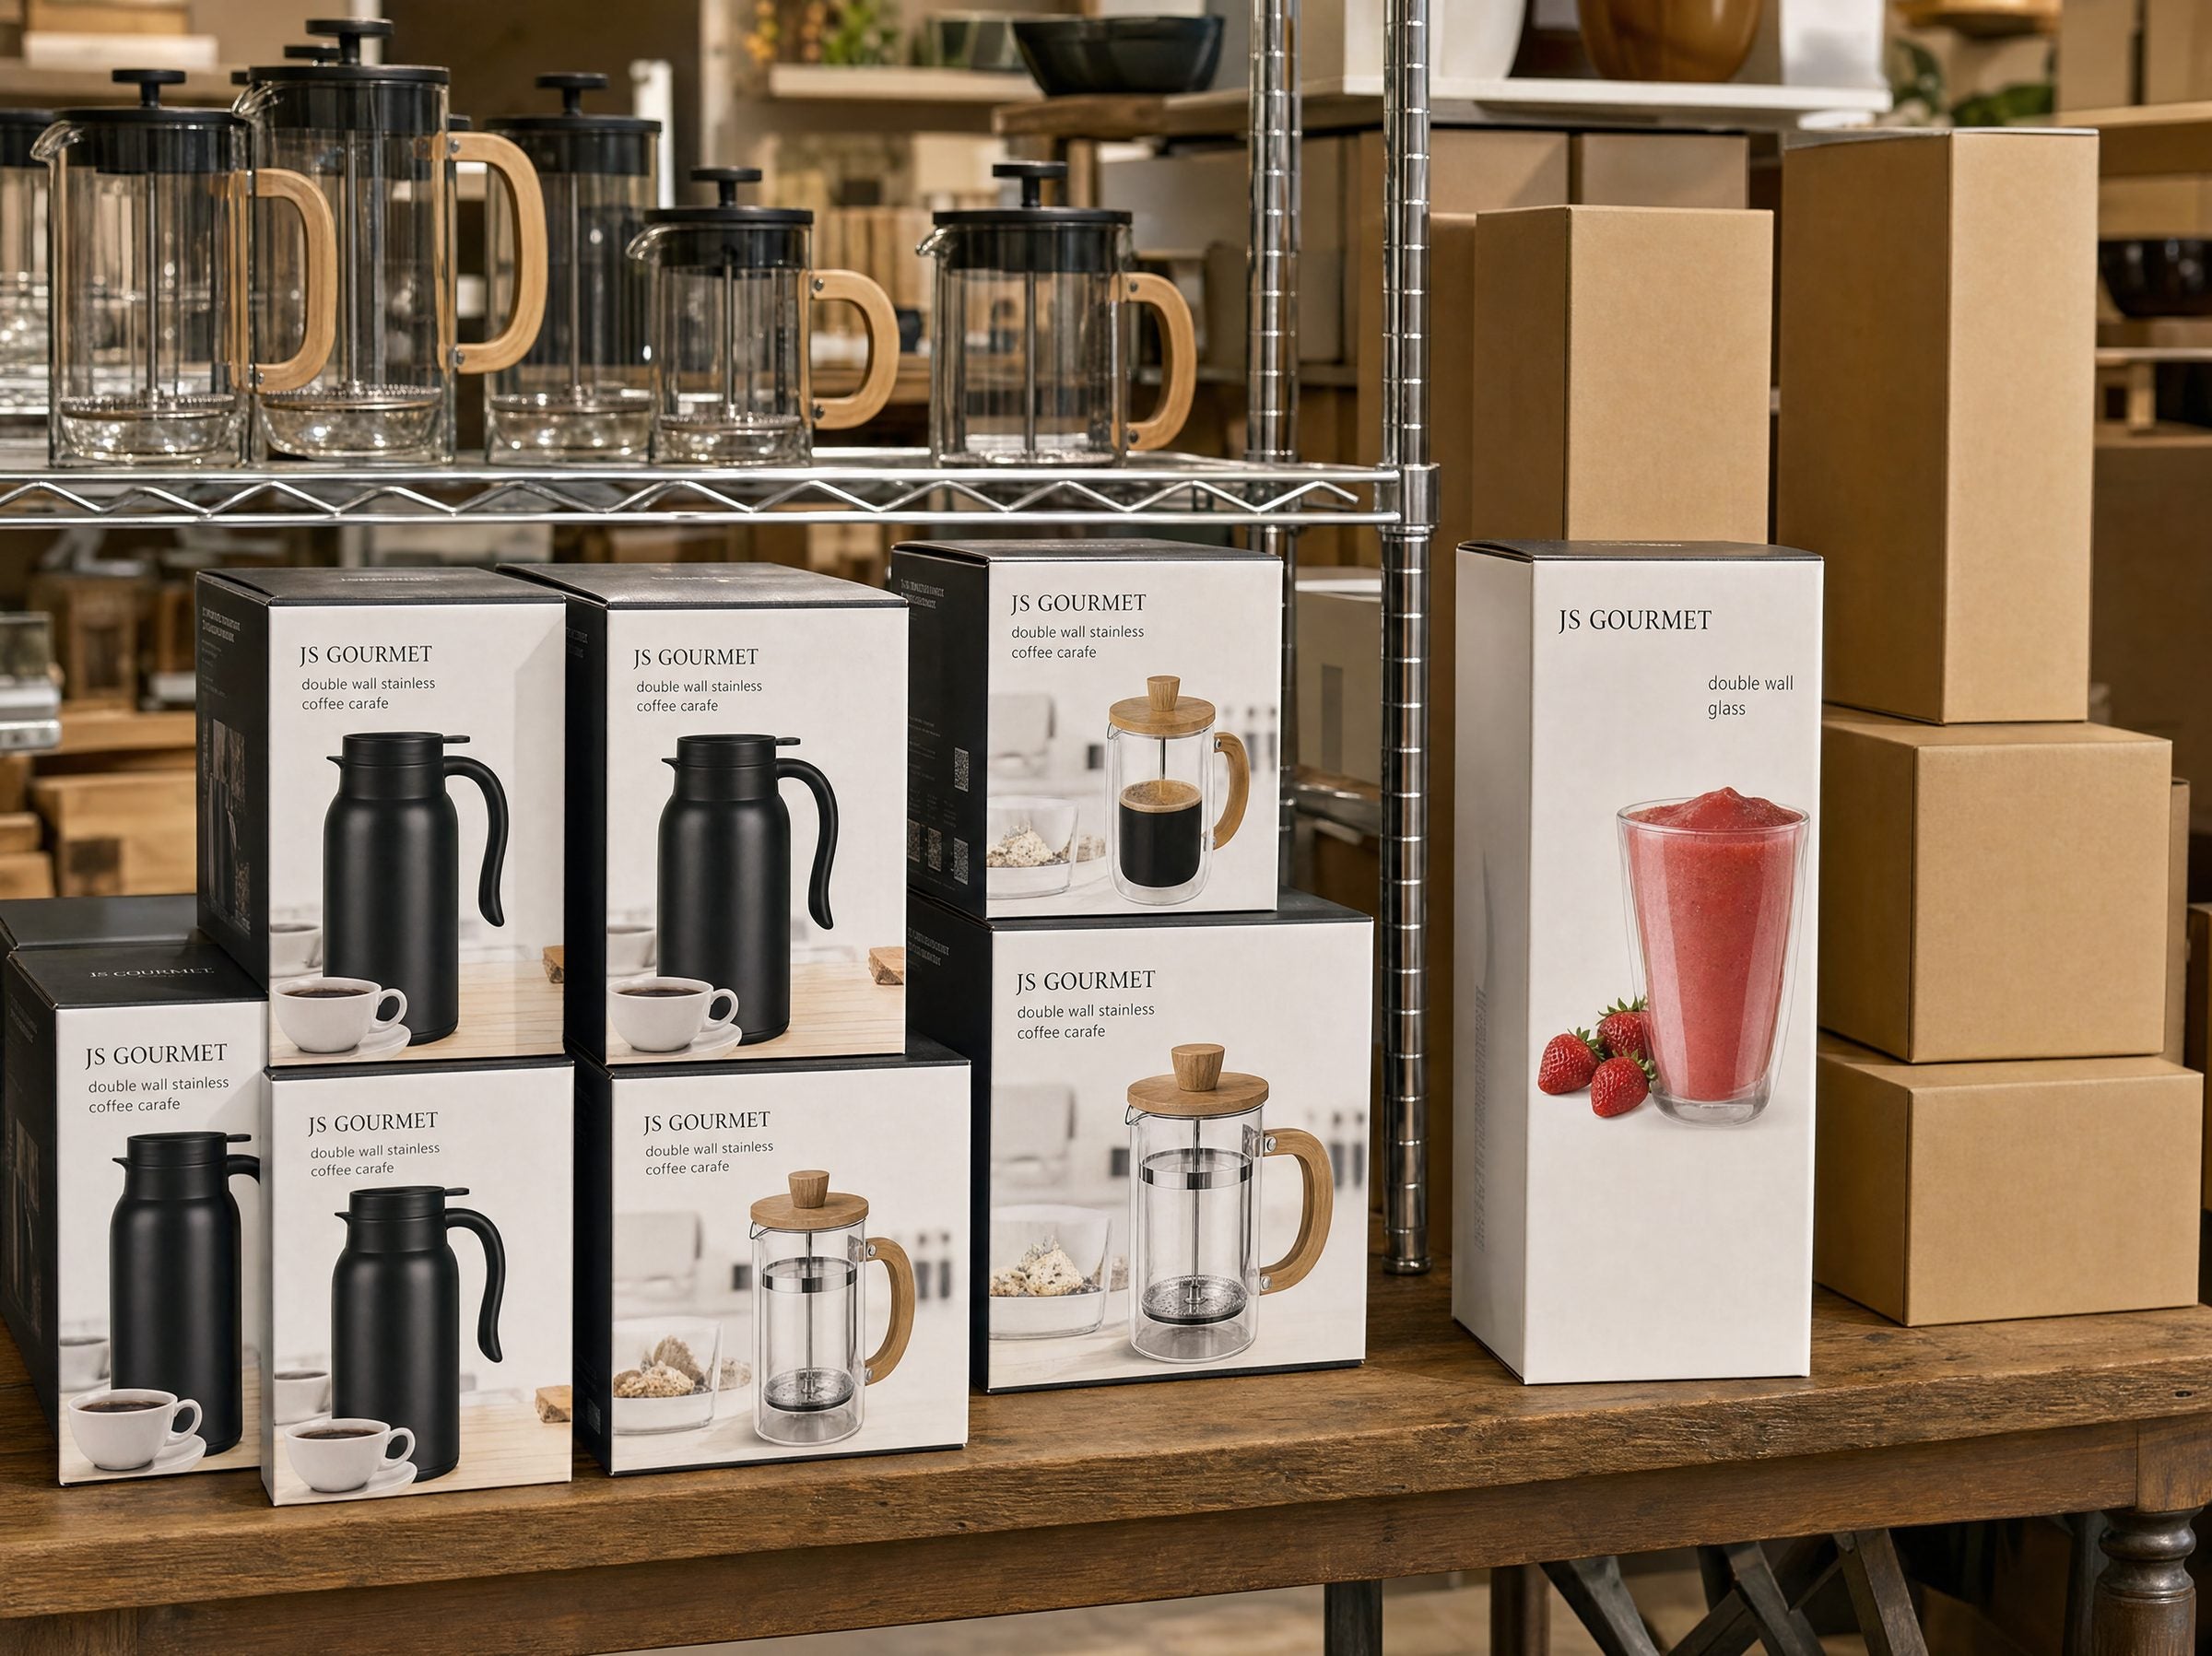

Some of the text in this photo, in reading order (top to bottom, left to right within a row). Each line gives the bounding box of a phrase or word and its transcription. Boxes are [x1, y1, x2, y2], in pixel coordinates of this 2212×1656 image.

[1011, 594, 1147, 616] JS GOURMET
[1559, 610, 1712, 634] JS GOURMET
[1012, 626, 1144, 638] double wall stainless
[300, 646, 432, 667] JS GOURMET
[634, 649, 759, 669] JS GOURMET
[1012, 645, 1096, 658] coffee carafe
[302, 677, 435, 690] double wall stainless
[637, 680, 762, 692] double wall stainless
[1709, 675, 1793, 690] double wall
[302, 697, 388, 710] coffee carafe
[637, 699, 718, 711] coffee carafe
[1709, 700, 1746, 720] glass
[1016, 970, 1155, 995] JS GOURMET
[1018, 1004, 1154, 1018] double wall stainless
[1018, 1025, 1105, 1039] coffee carafe
[86, 1043, 227, 1070] JS GOURMET
[88, 1076, 229, 1093] double wall stainless
[89, 1098, 180, 1113] coffee carafe
[309, 1112, 438, 1137] JS GOURMET
[643, 1111, 771, 1135] JS GOURMET
[311, 1143, 440, 1158] double wall stainless
[646, 1141, 773, 1157] double wall stainless
[312, 1162, 394, 1177] coffee carafe
[646, 1160, 729, 1175] coffee carafe
